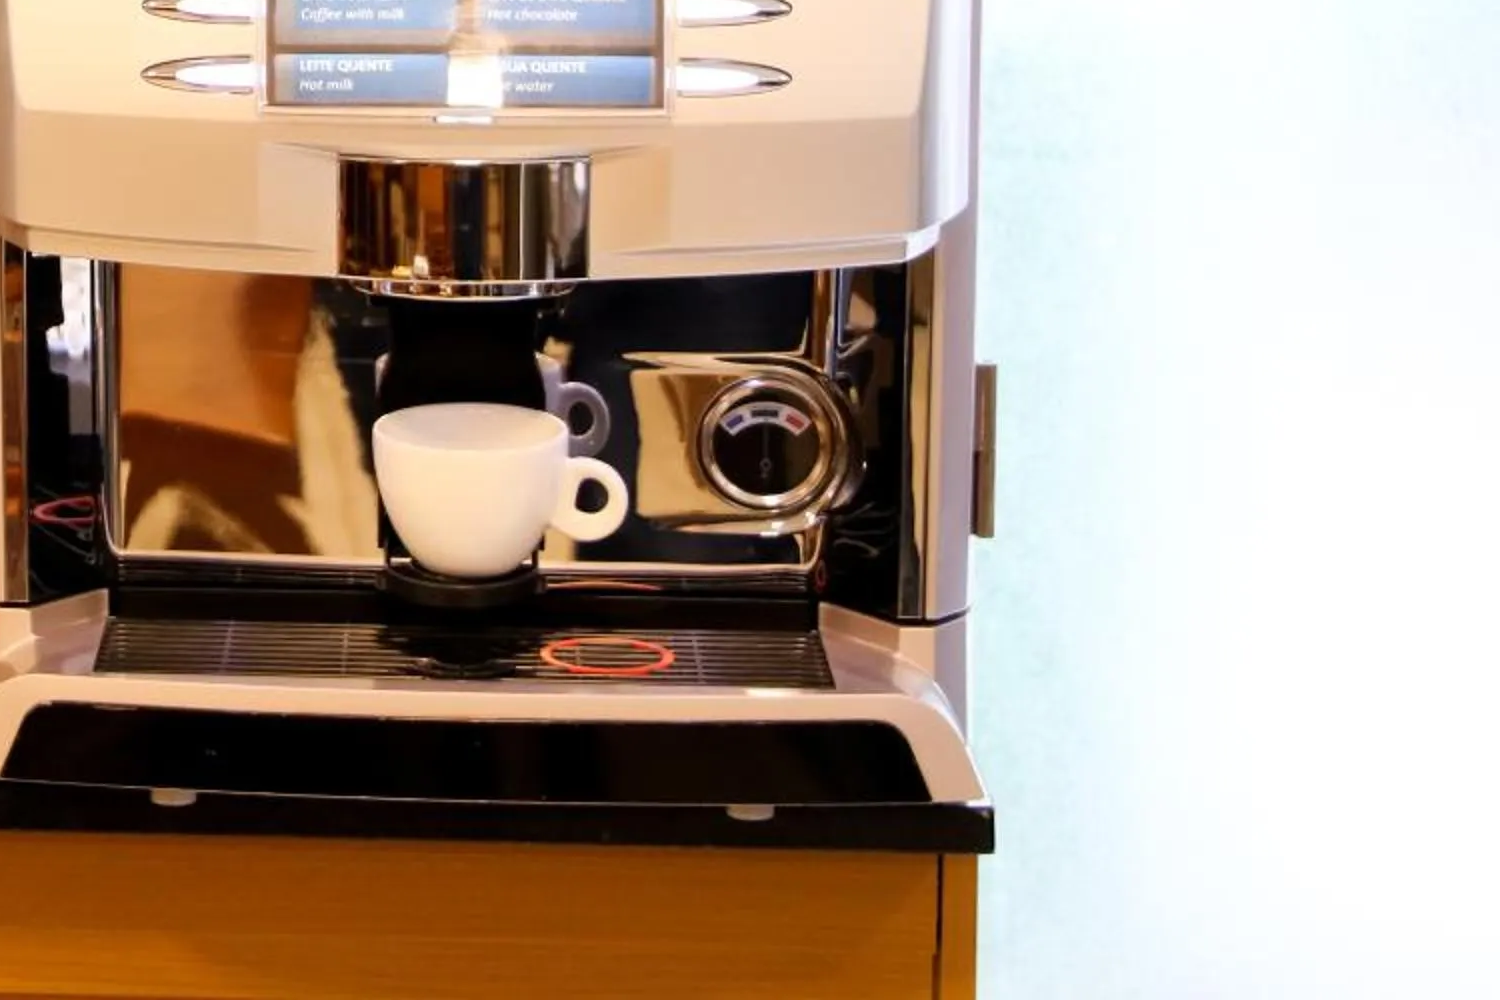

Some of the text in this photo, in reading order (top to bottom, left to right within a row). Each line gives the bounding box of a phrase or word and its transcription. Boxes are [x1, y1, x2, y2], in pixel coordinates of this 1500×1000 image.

[301, 7, 343, 23] Coffee
[345, 7, 375, 20] with
[514, 8, 578, 21] chocolate
[300, 59, 394, 74] LEITE QUENTE
[530, 60, 587, 75] QUENTE
[300, 78, 354, 91] Hot milk
[515, 81, 554, 92] water
